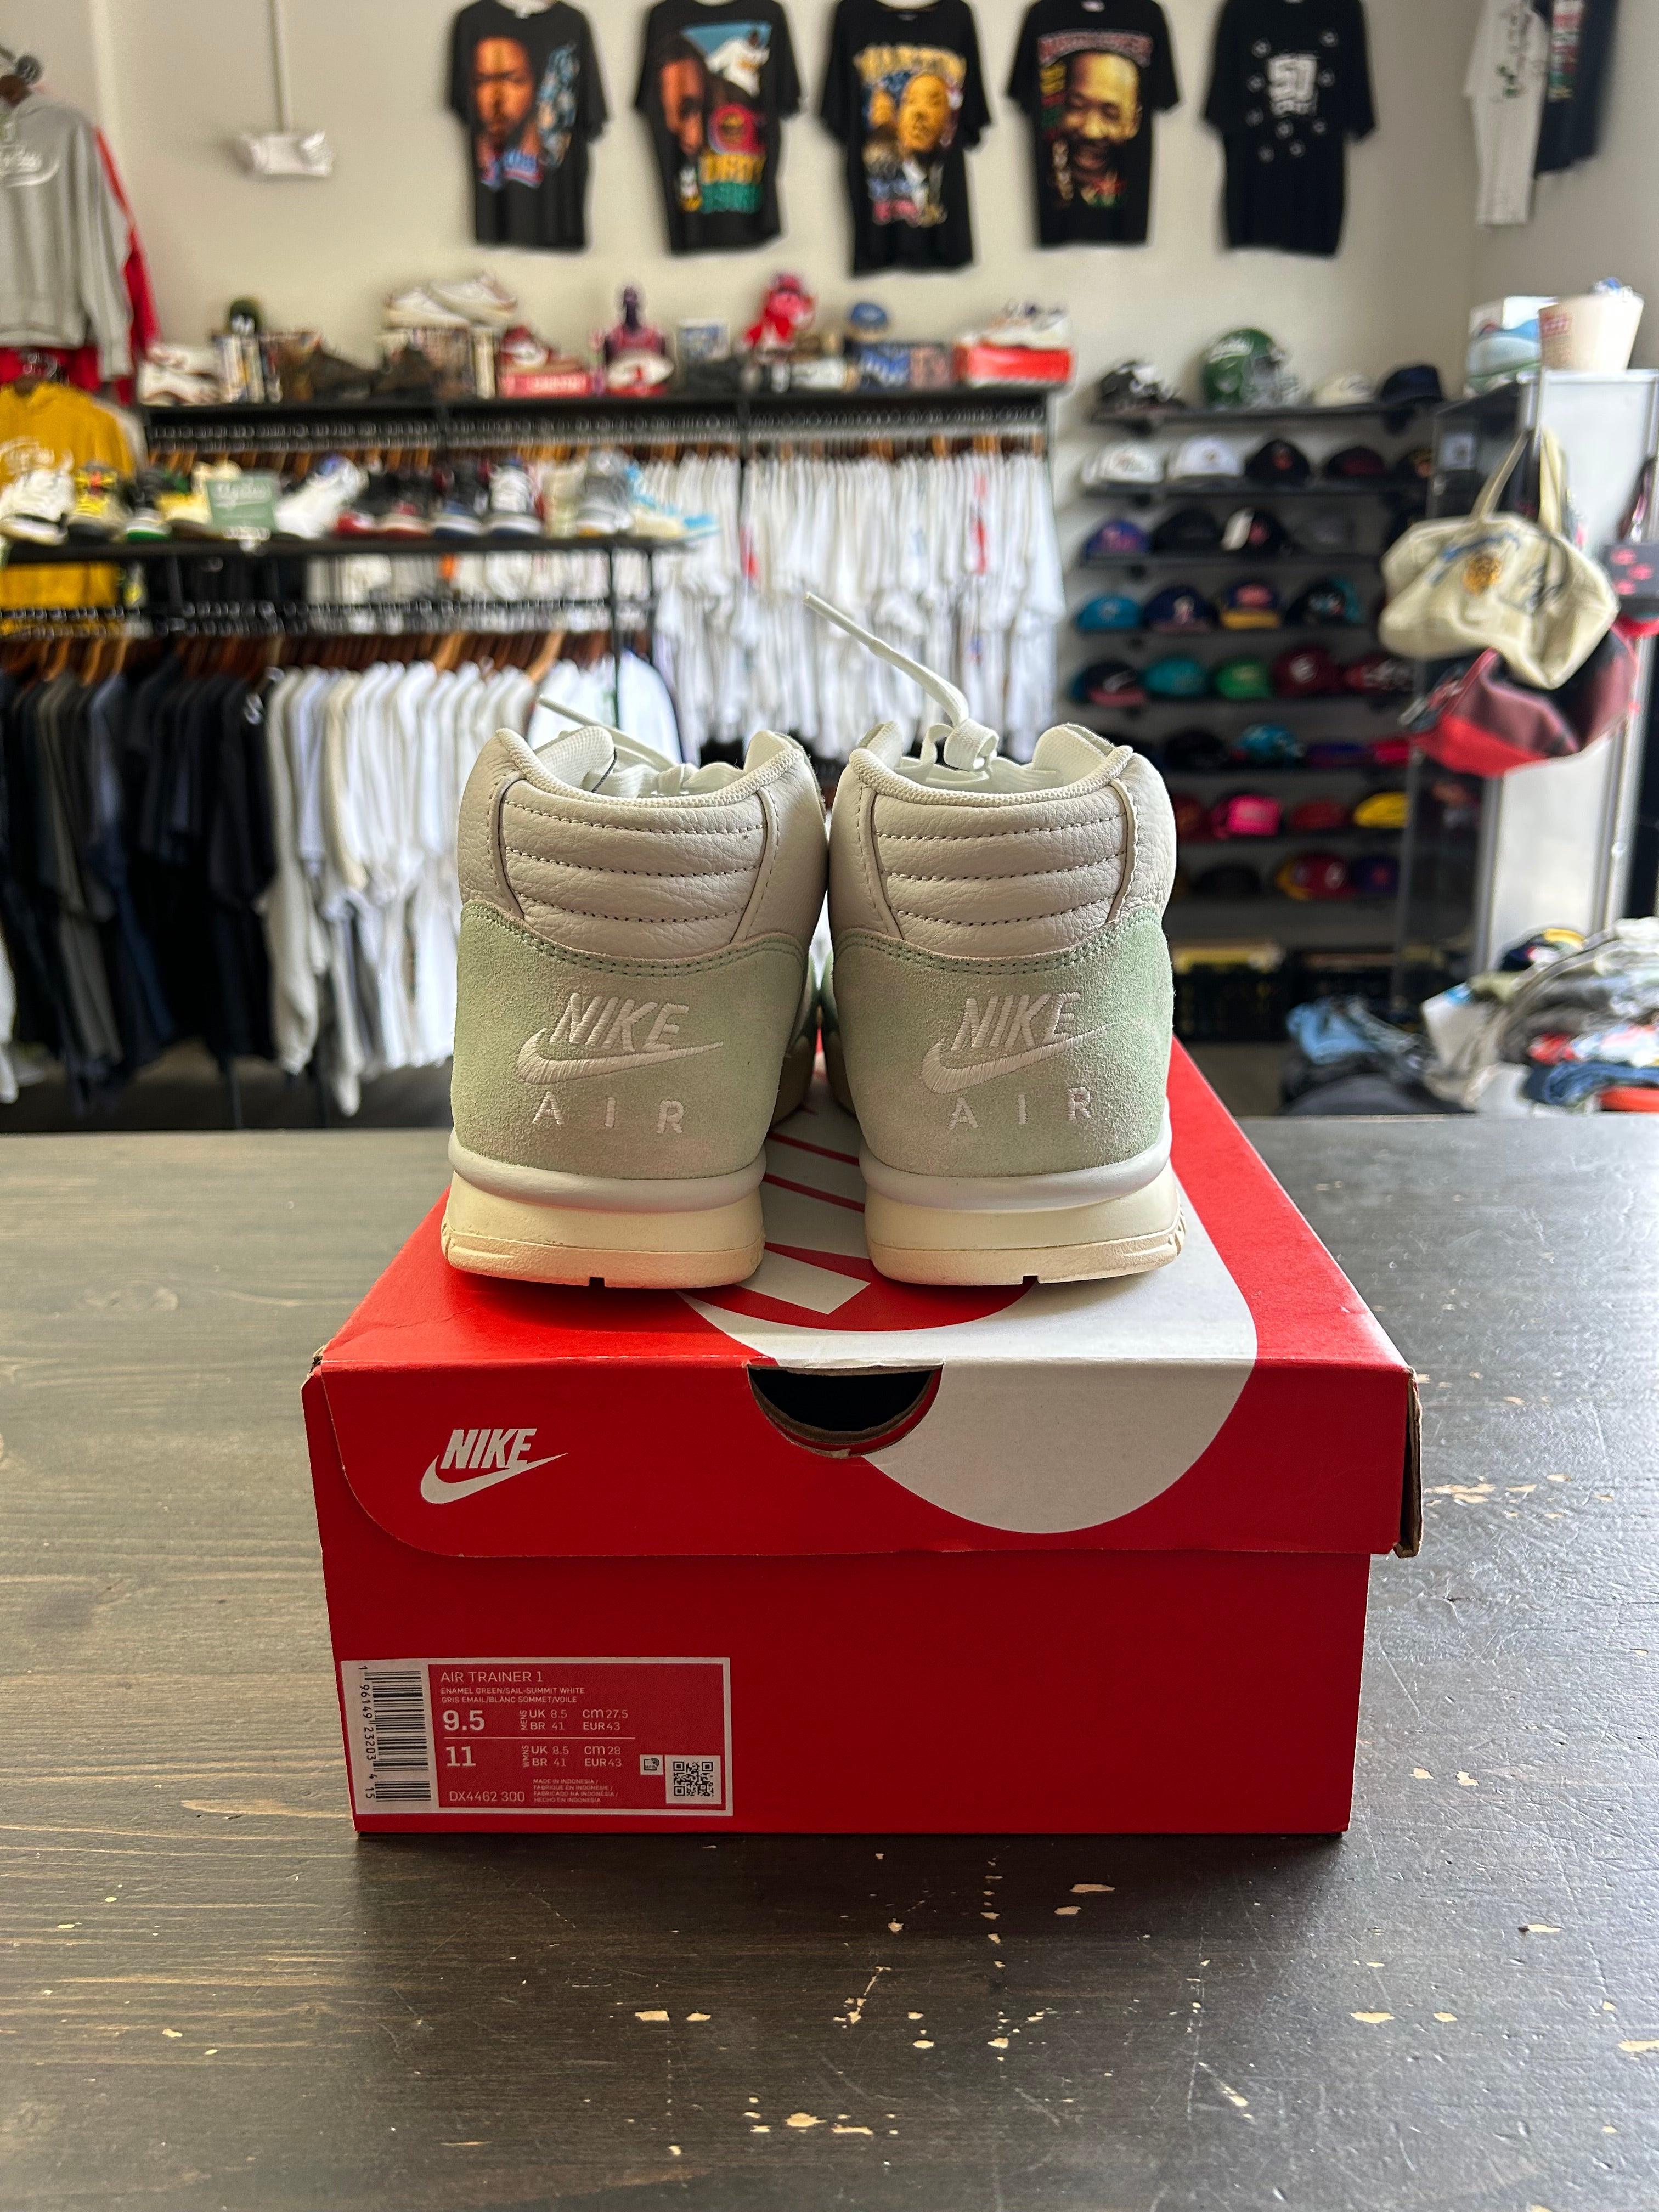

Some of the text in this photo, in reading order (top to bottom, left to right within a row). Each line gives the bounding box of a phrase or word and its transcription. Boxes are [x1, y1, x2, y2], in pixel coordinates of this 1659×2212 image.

[549, 992, 690, 1052] NIKE
[951, 991, 1081, 1051] NIKE
[440, 1428, 537, 1469] NIKE
[441, 1671, 544, 1683] AIR TRAINER 1
[360, 1684, 373, 1719] 96149
[443, 1709, 485, 1731] 9.5
[519, 1709, 528, 1730] MENS
[529, 1709, 546, 1718] UK
[550, 1709, 568, 1718] 8.5
[606, 1709, 628, 1718] 27.5
[530, 1722, 620, 1730] BR 41 EUR 43
[364, 1726, 376, 1761] 23203
[531, 1745, 548, 1754] UK
[552, 1746, 569, 1755] 8.5
[607, 1746, 621, 1755] 28
[445, 1746, 477, 1767] 11
[521, 1745, 530, 1768] WMNS
[532, 1758, 622, 1767] BR 41 EUR 43
[449, 1791, 525, 1802] DX4462 300
